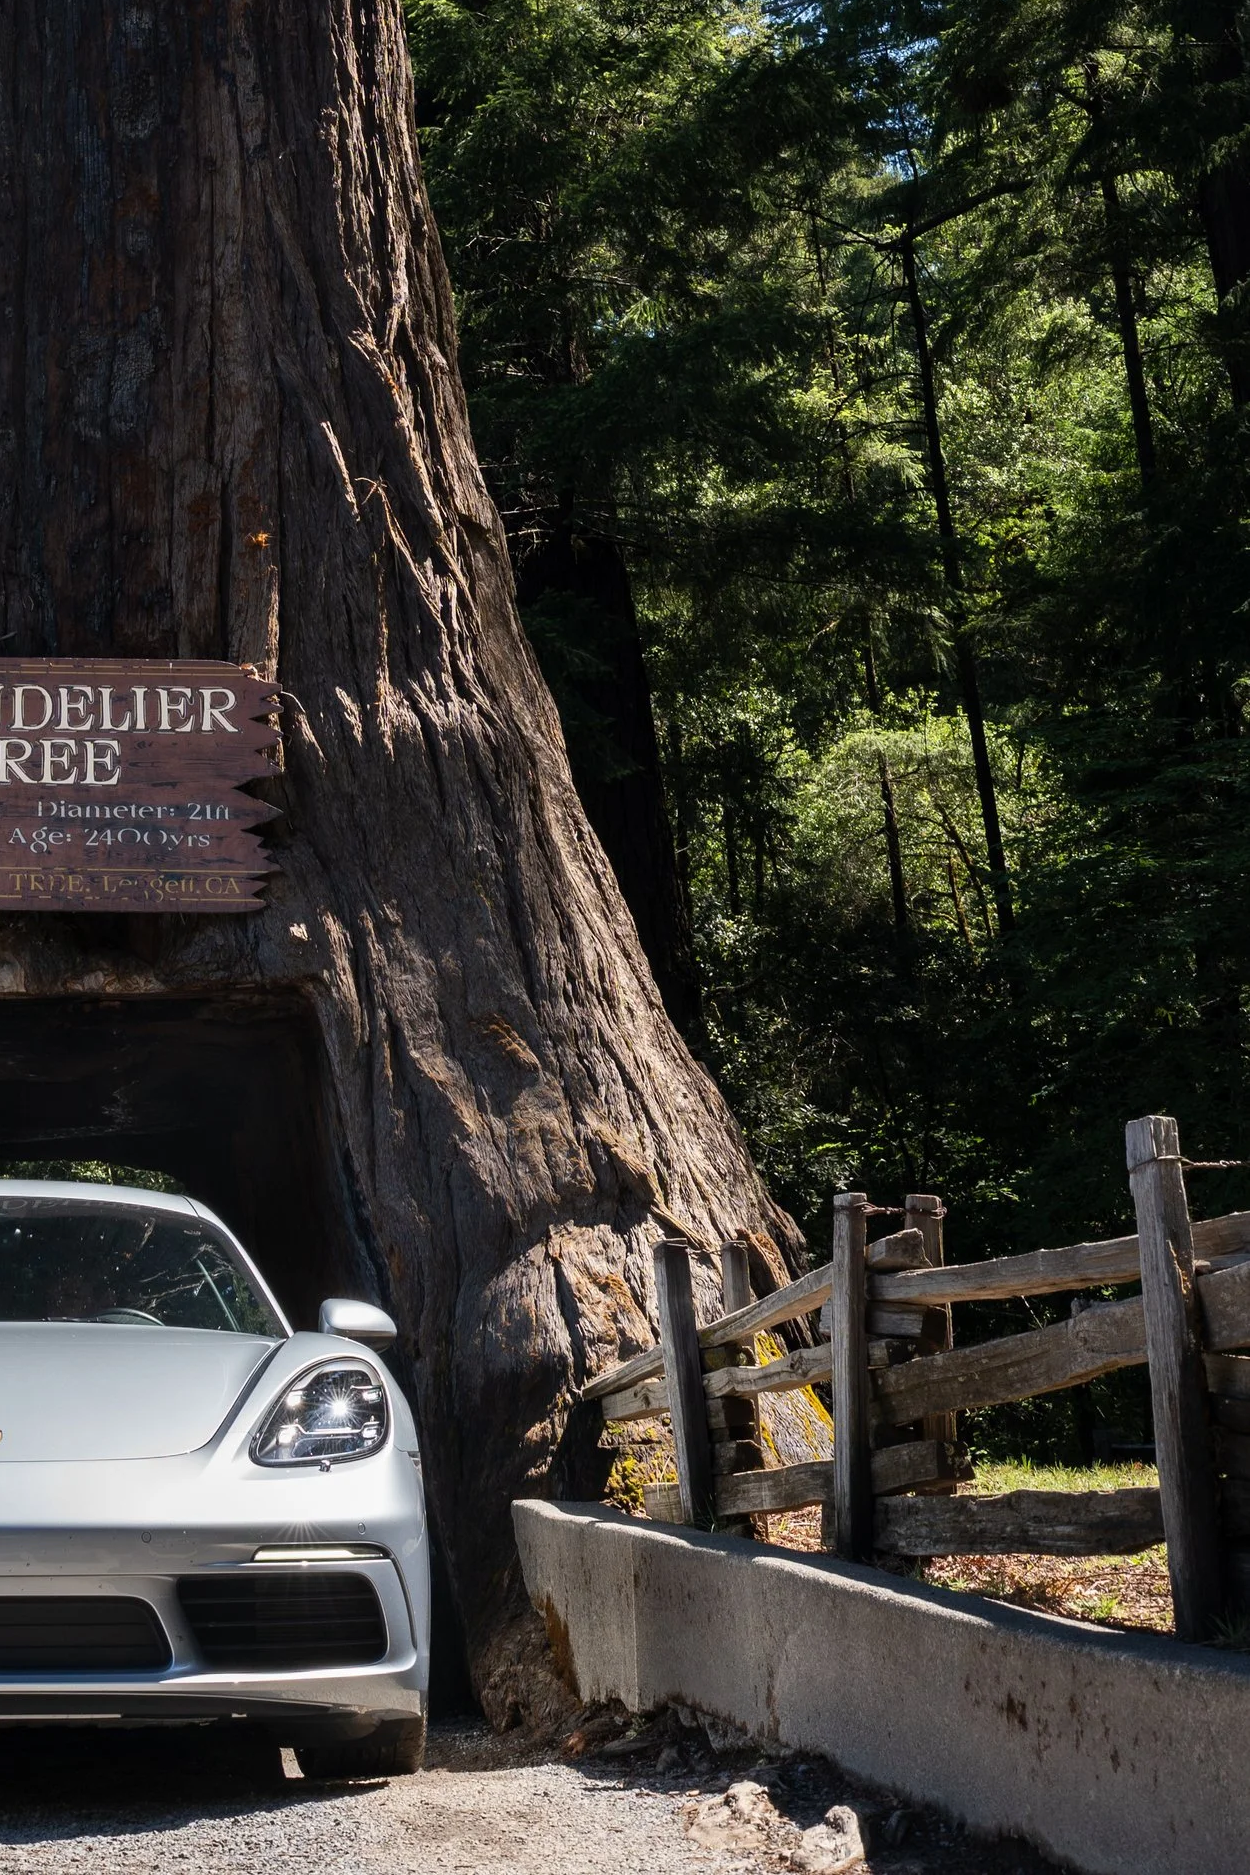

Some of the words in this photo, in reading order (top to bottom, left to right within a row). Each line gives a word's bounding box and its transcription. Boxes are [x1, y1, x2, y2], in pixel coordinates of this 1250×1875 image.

[37, 799, 175, 819] Diameter:
[187, 803, 230, 820] 21ft
[8, 826, 72, 853] Age:
[84, 828, 211, 851] 2400yrs
[205, 877, 241, 894] CA
